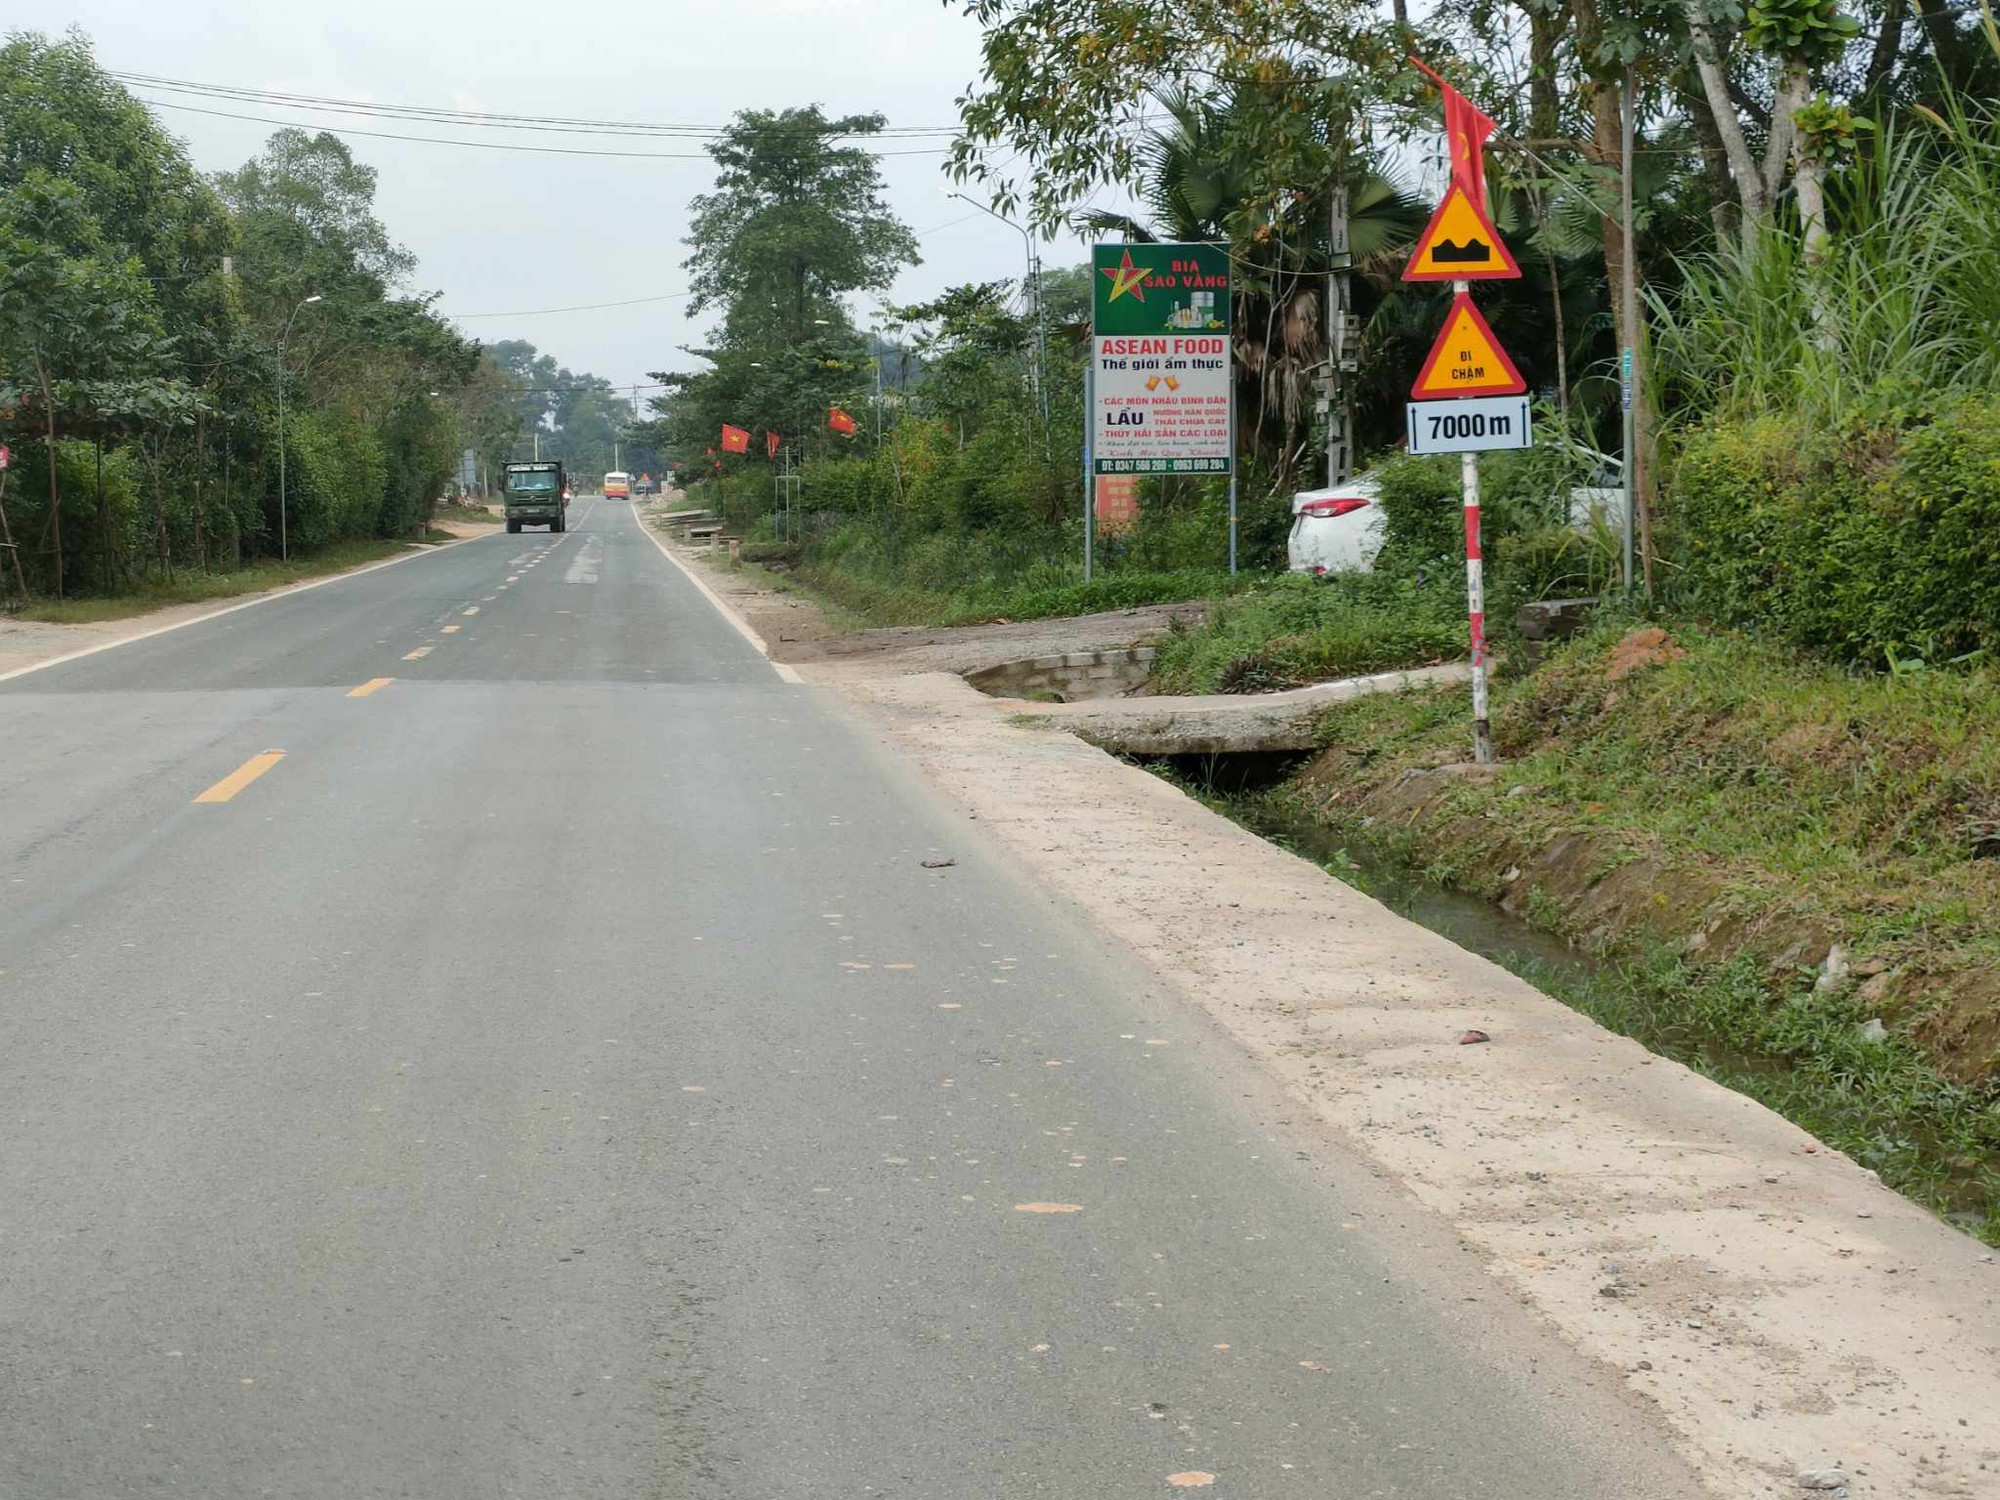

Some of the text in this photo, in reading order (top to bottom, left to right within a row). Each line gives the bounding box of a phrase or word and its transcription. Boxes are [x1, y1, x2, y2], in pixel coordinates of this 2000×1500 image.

[1171, 259, 1200, 272] BIA
[1144, 273, 1228, 289] SAO VÀNG
[1101, 338, 1224, 355] ASEAN FOOD
[1101, 356, 1127, 370] Thế
[1132, 358, 1160, 371] giới
[1192, 358, 1224, 372] thực
[1460, 350, 1472, 362] ĐI
[1451, 365, 1485, 382] CHẬM
[1106, 407, 1144, 426] LẨU
[1427, 414, 1511, 440] 7000 m
